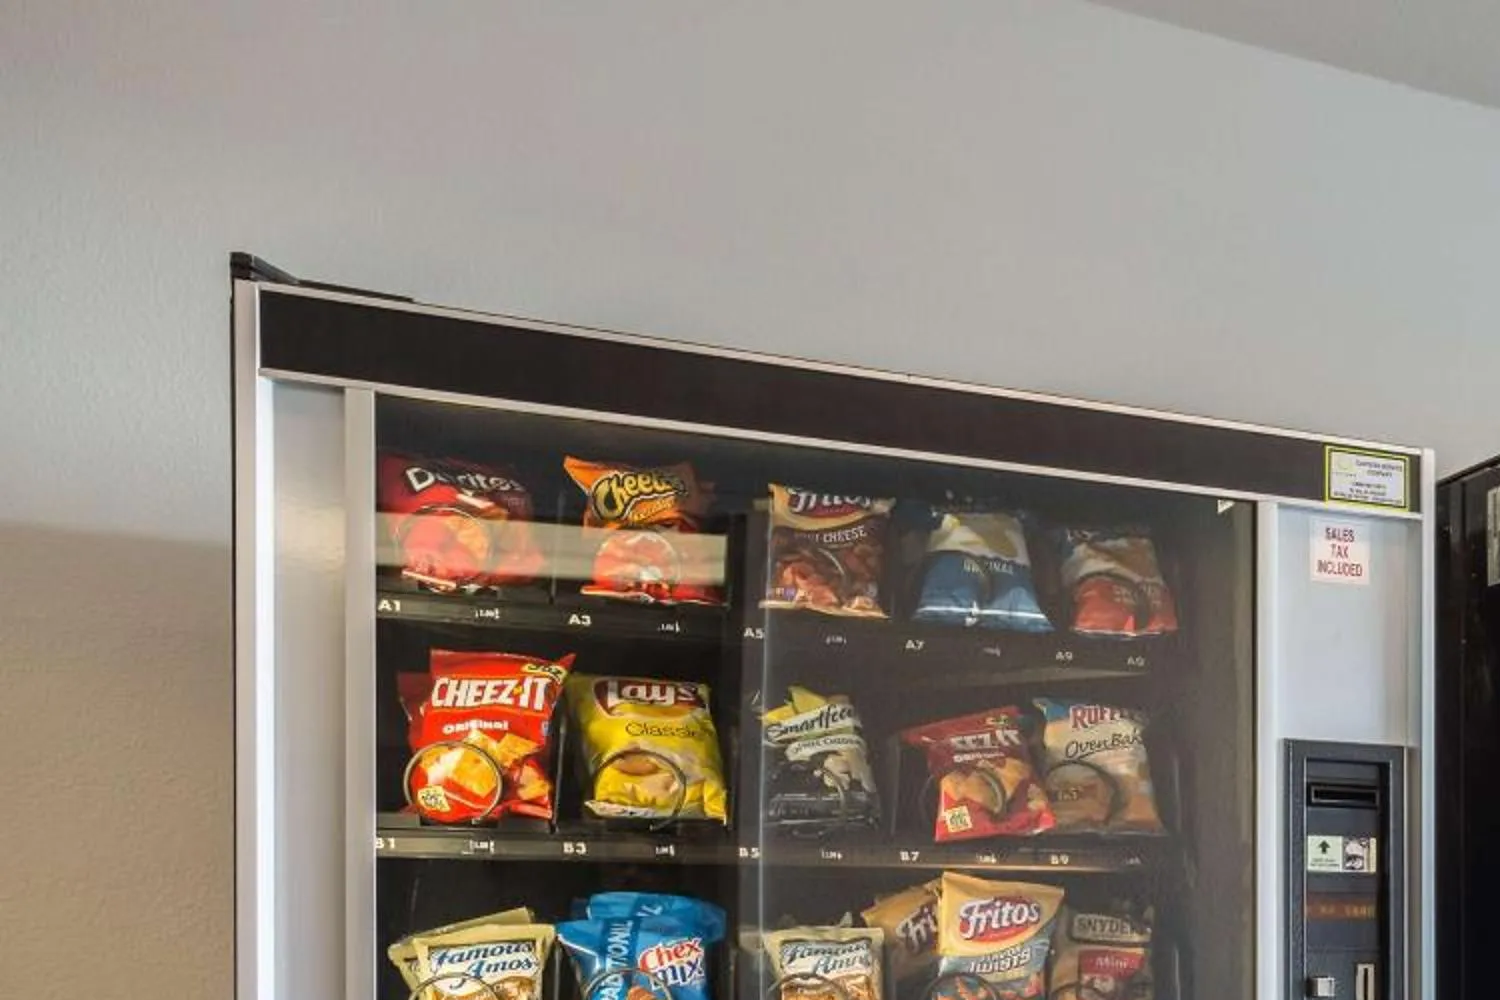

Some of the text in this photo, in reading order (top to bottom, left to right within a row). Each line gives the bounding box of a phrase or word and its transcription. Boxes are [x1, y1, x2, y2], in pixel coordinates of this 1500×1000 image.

[823, 525, 868, 543] CHEESE
[1325, 527, 1355, 543] SALES
[1331, 544, 1349, 559] TAX
[1317, 559, 1363, 577] INCLUDED
[378, 600, 400, 612] A1
[569, 614, 591, 626] A3
[744, 627, 764, 639] A5
[905, 640, 925, 651] A7
[1066, 739, 1107, 758] Oven
[375, 837, 395, 849] B1
[564, 842, 586, 855] B3
[740, 847, 761, 859] B5
[901, 851, 919, 862] B7
[959, 897, 1042, 939] Fritos
[430, 942, 535, 970] Famous
[638, 938, 705, 972] Chex
[467, 958, 538, 979] Amos
